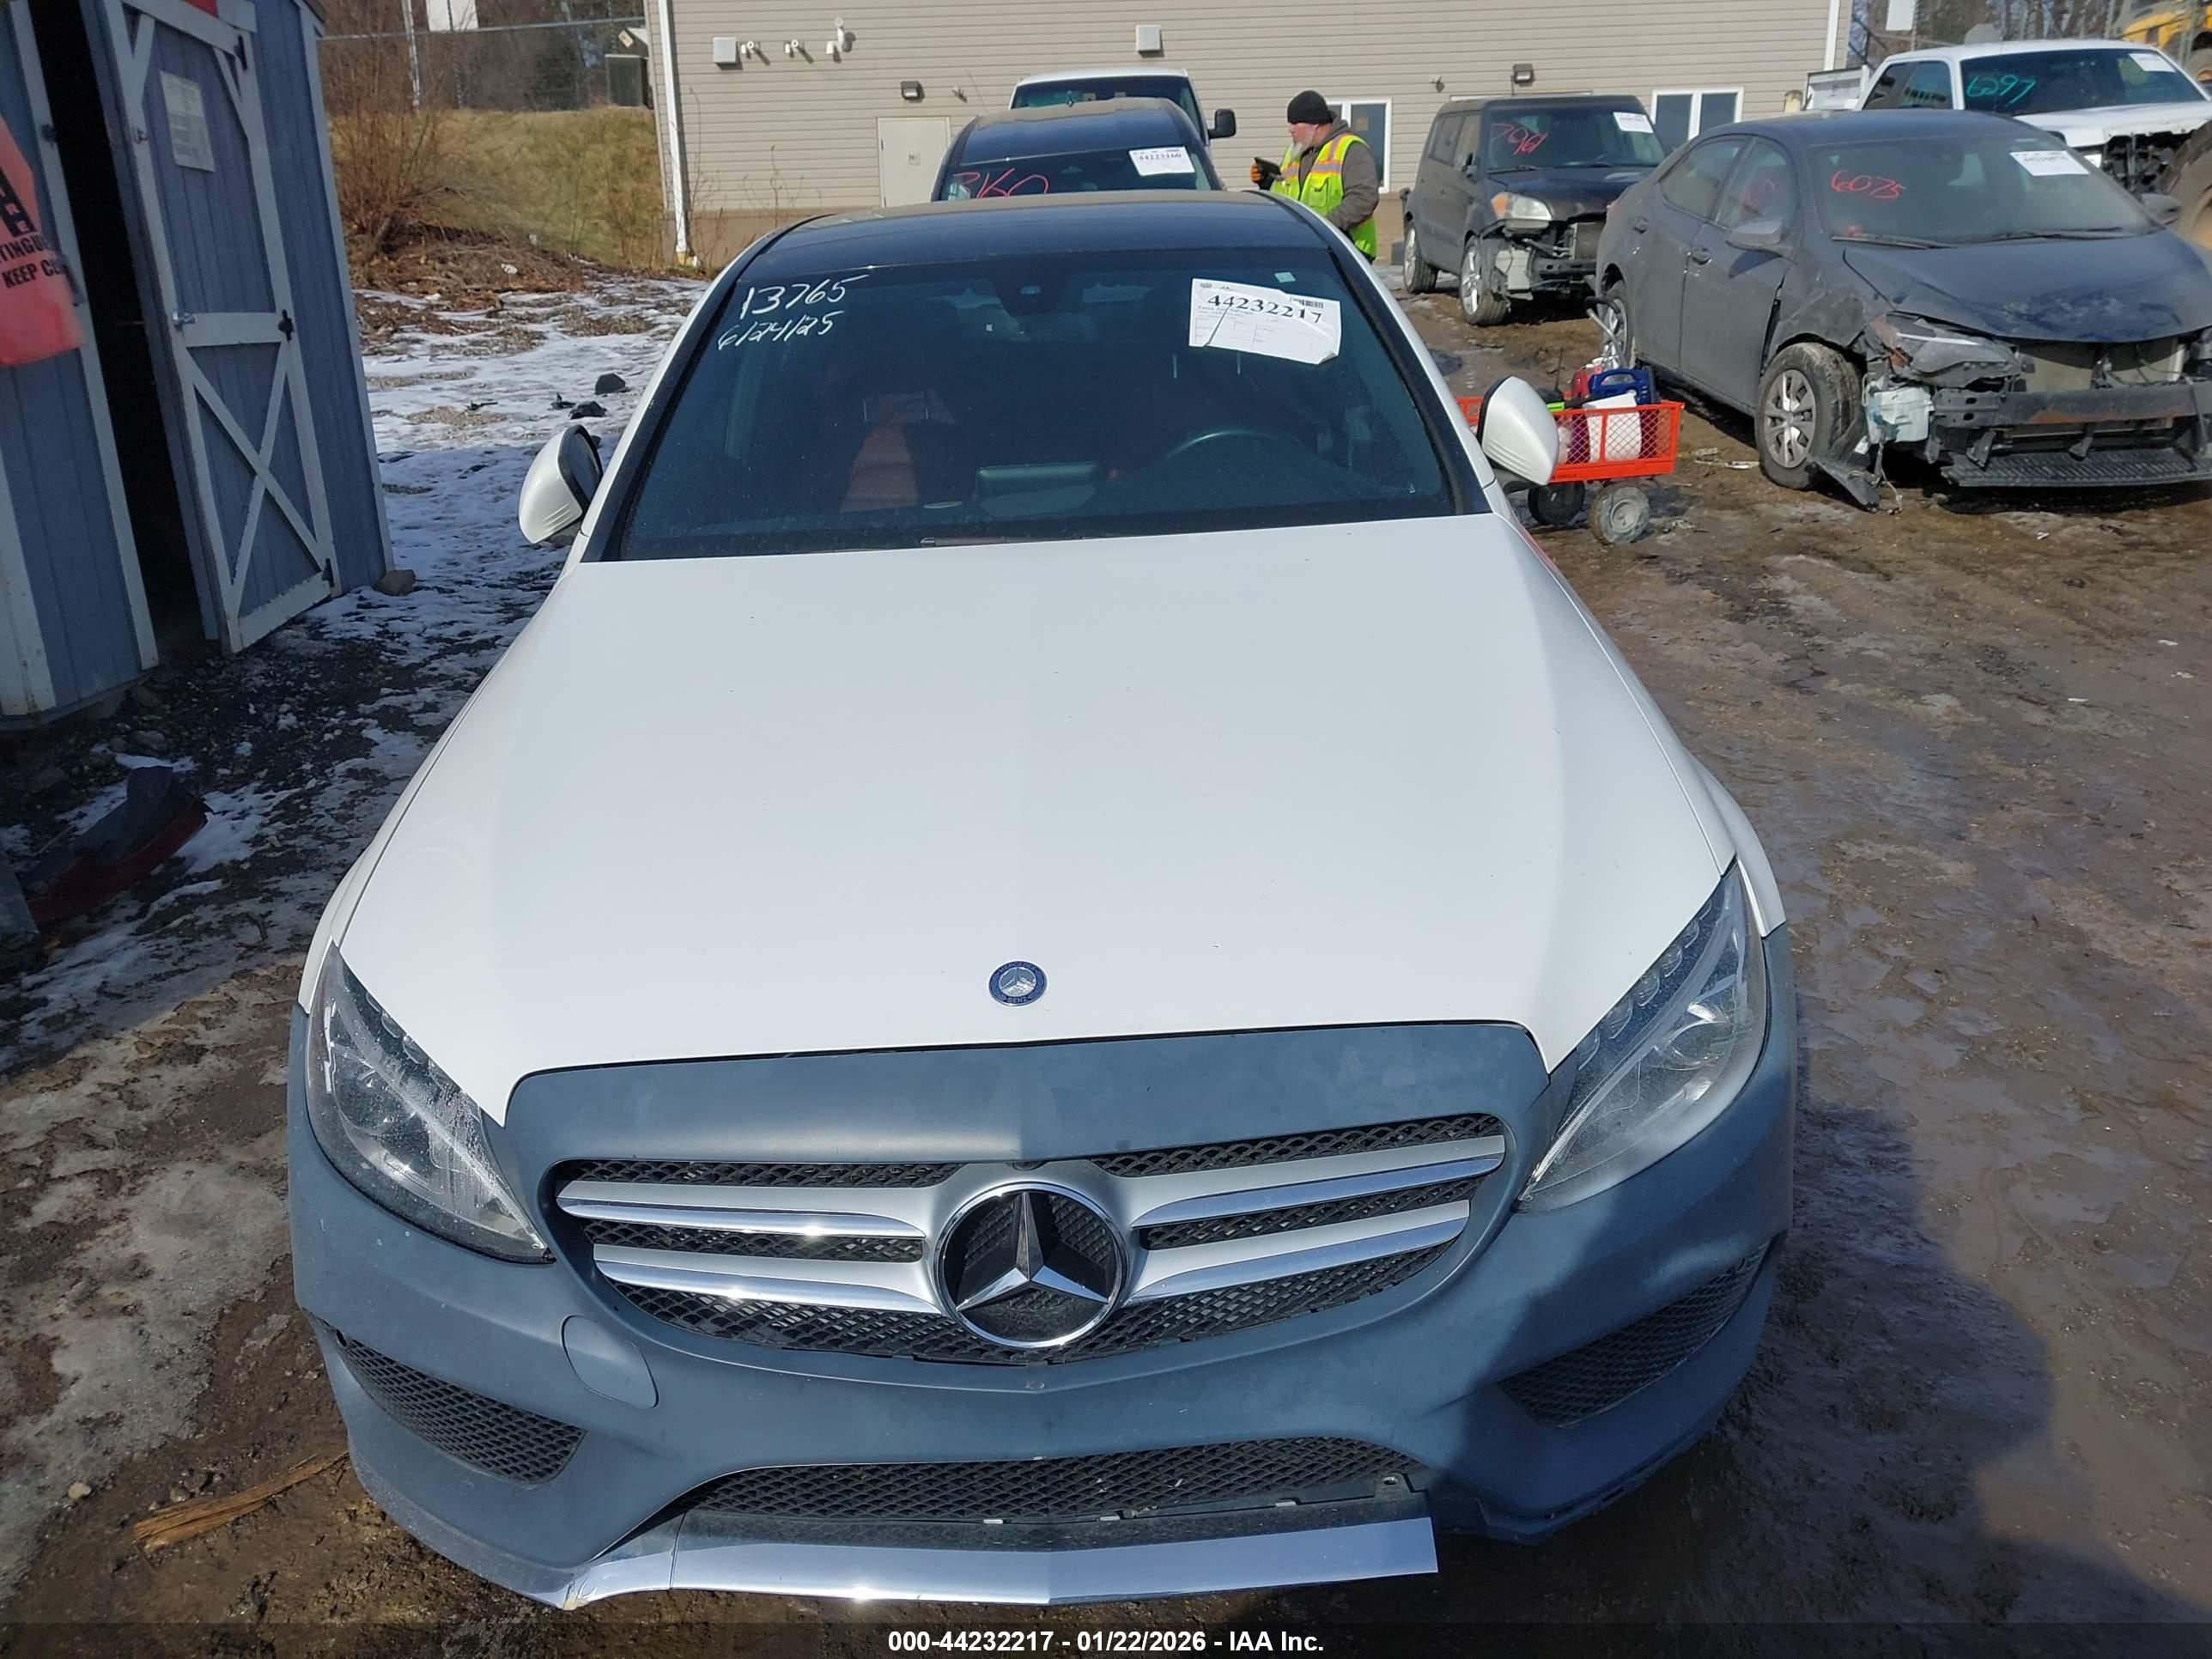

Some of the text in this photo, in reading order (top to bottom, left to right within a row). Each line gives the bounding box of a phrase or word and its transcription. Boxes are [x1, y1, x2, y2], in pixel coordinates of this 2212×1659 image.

[2, 263, 38, 289] KEEP
[739, 274, 870, 319] 13765
[1207, 295, 1322, 324] 44232217
